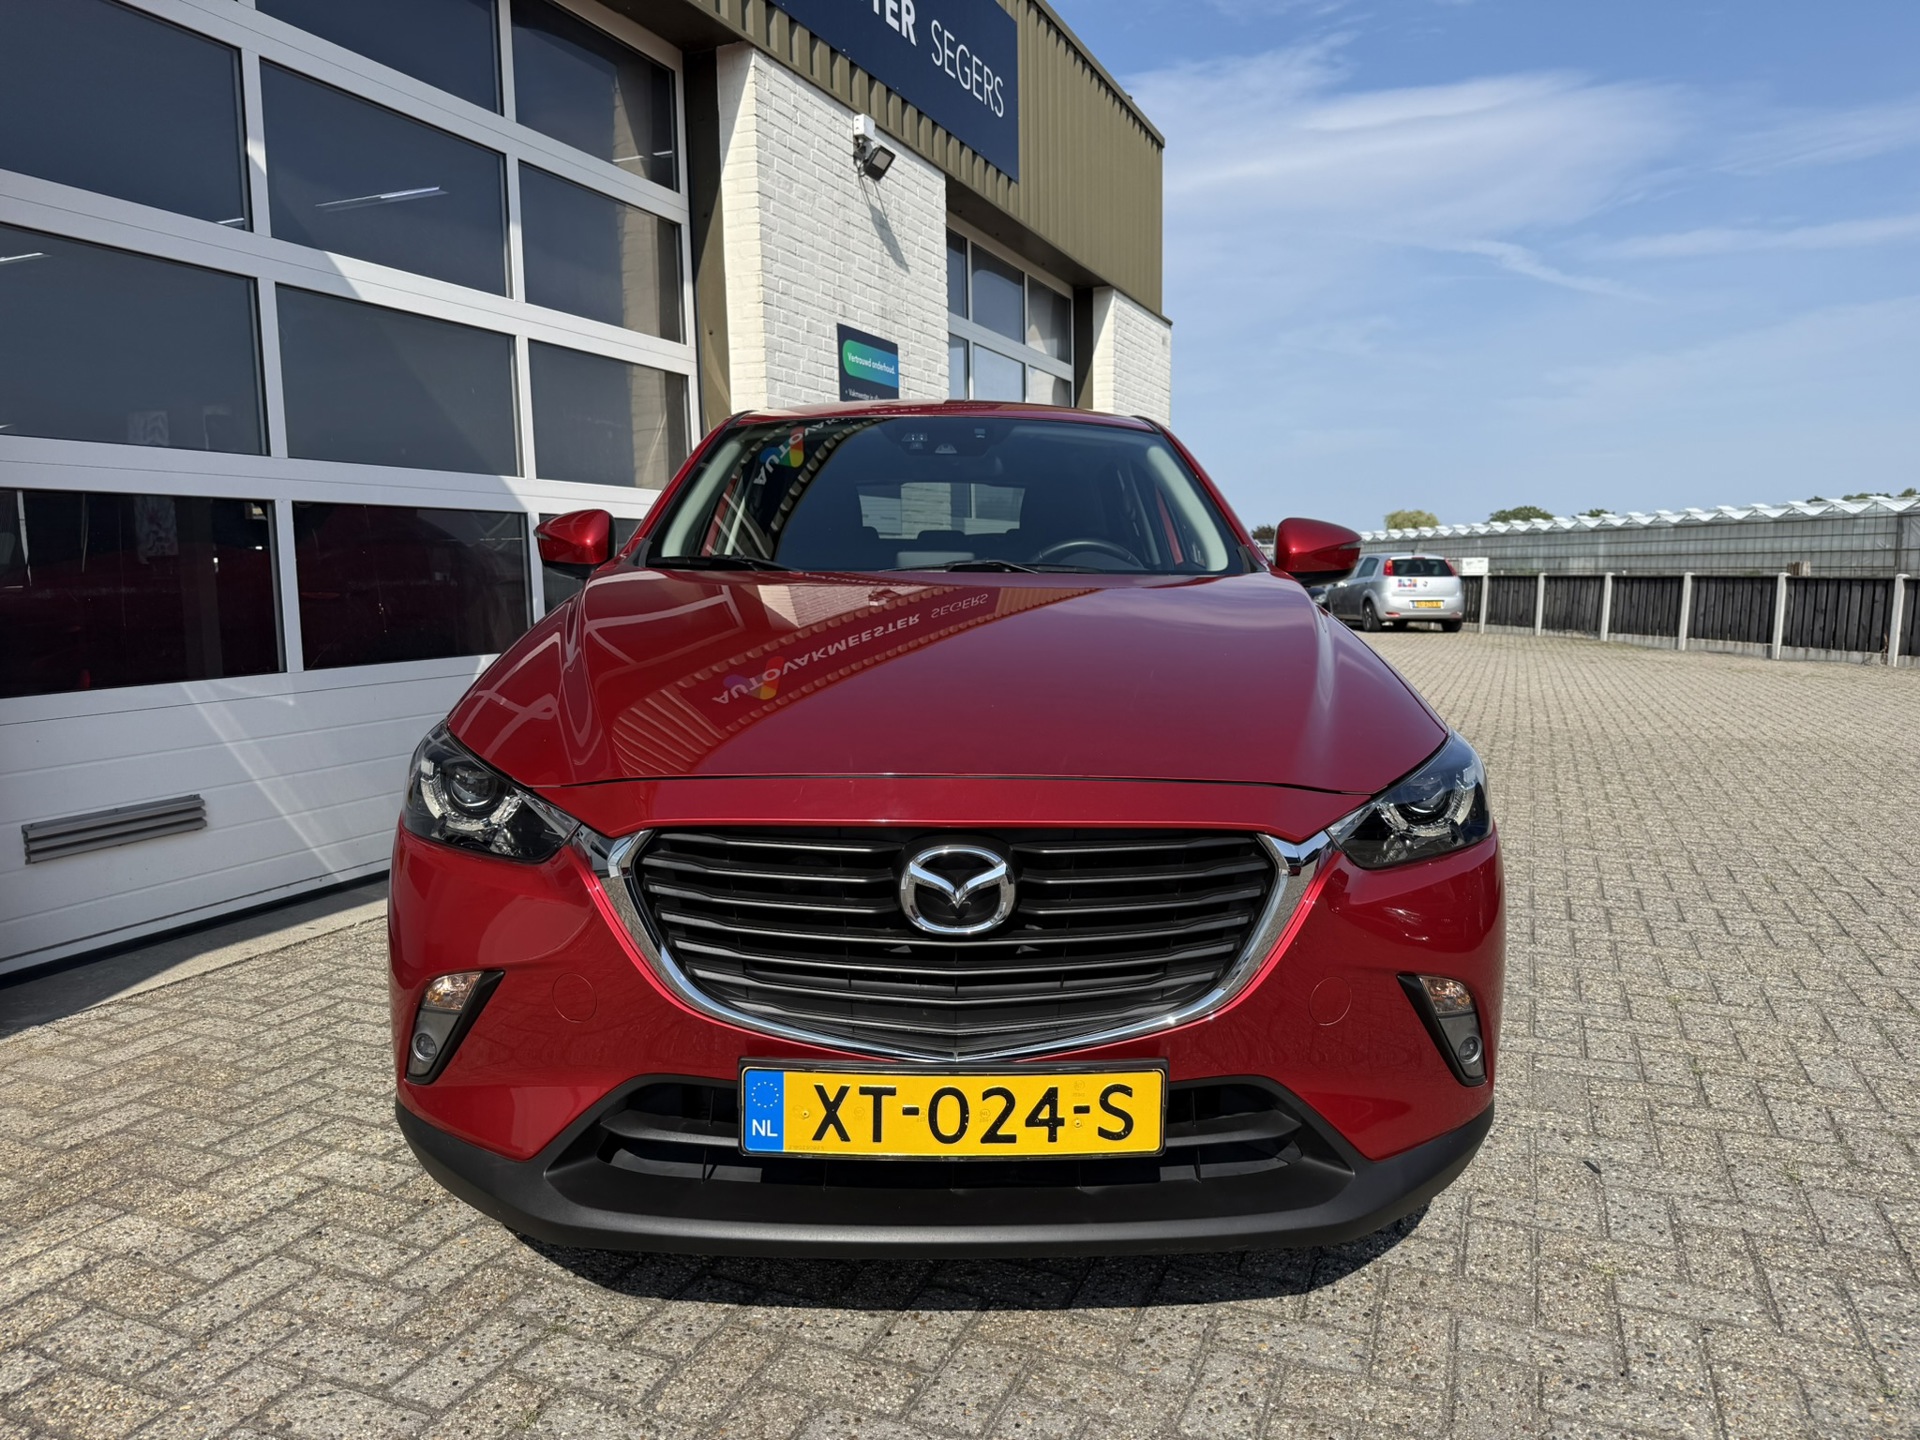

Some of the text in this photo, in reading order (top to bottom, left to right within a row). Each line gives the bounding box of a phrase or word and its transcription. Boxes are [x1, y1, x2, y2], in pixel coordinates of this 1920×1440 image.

[931, 19, 1004, 118] SEGERS
[847, 351, 872, 368] Vertrouwd
[751, 1119, 778, 1137] NL
[811, 1083, 1134, 1144] XT-024-S
